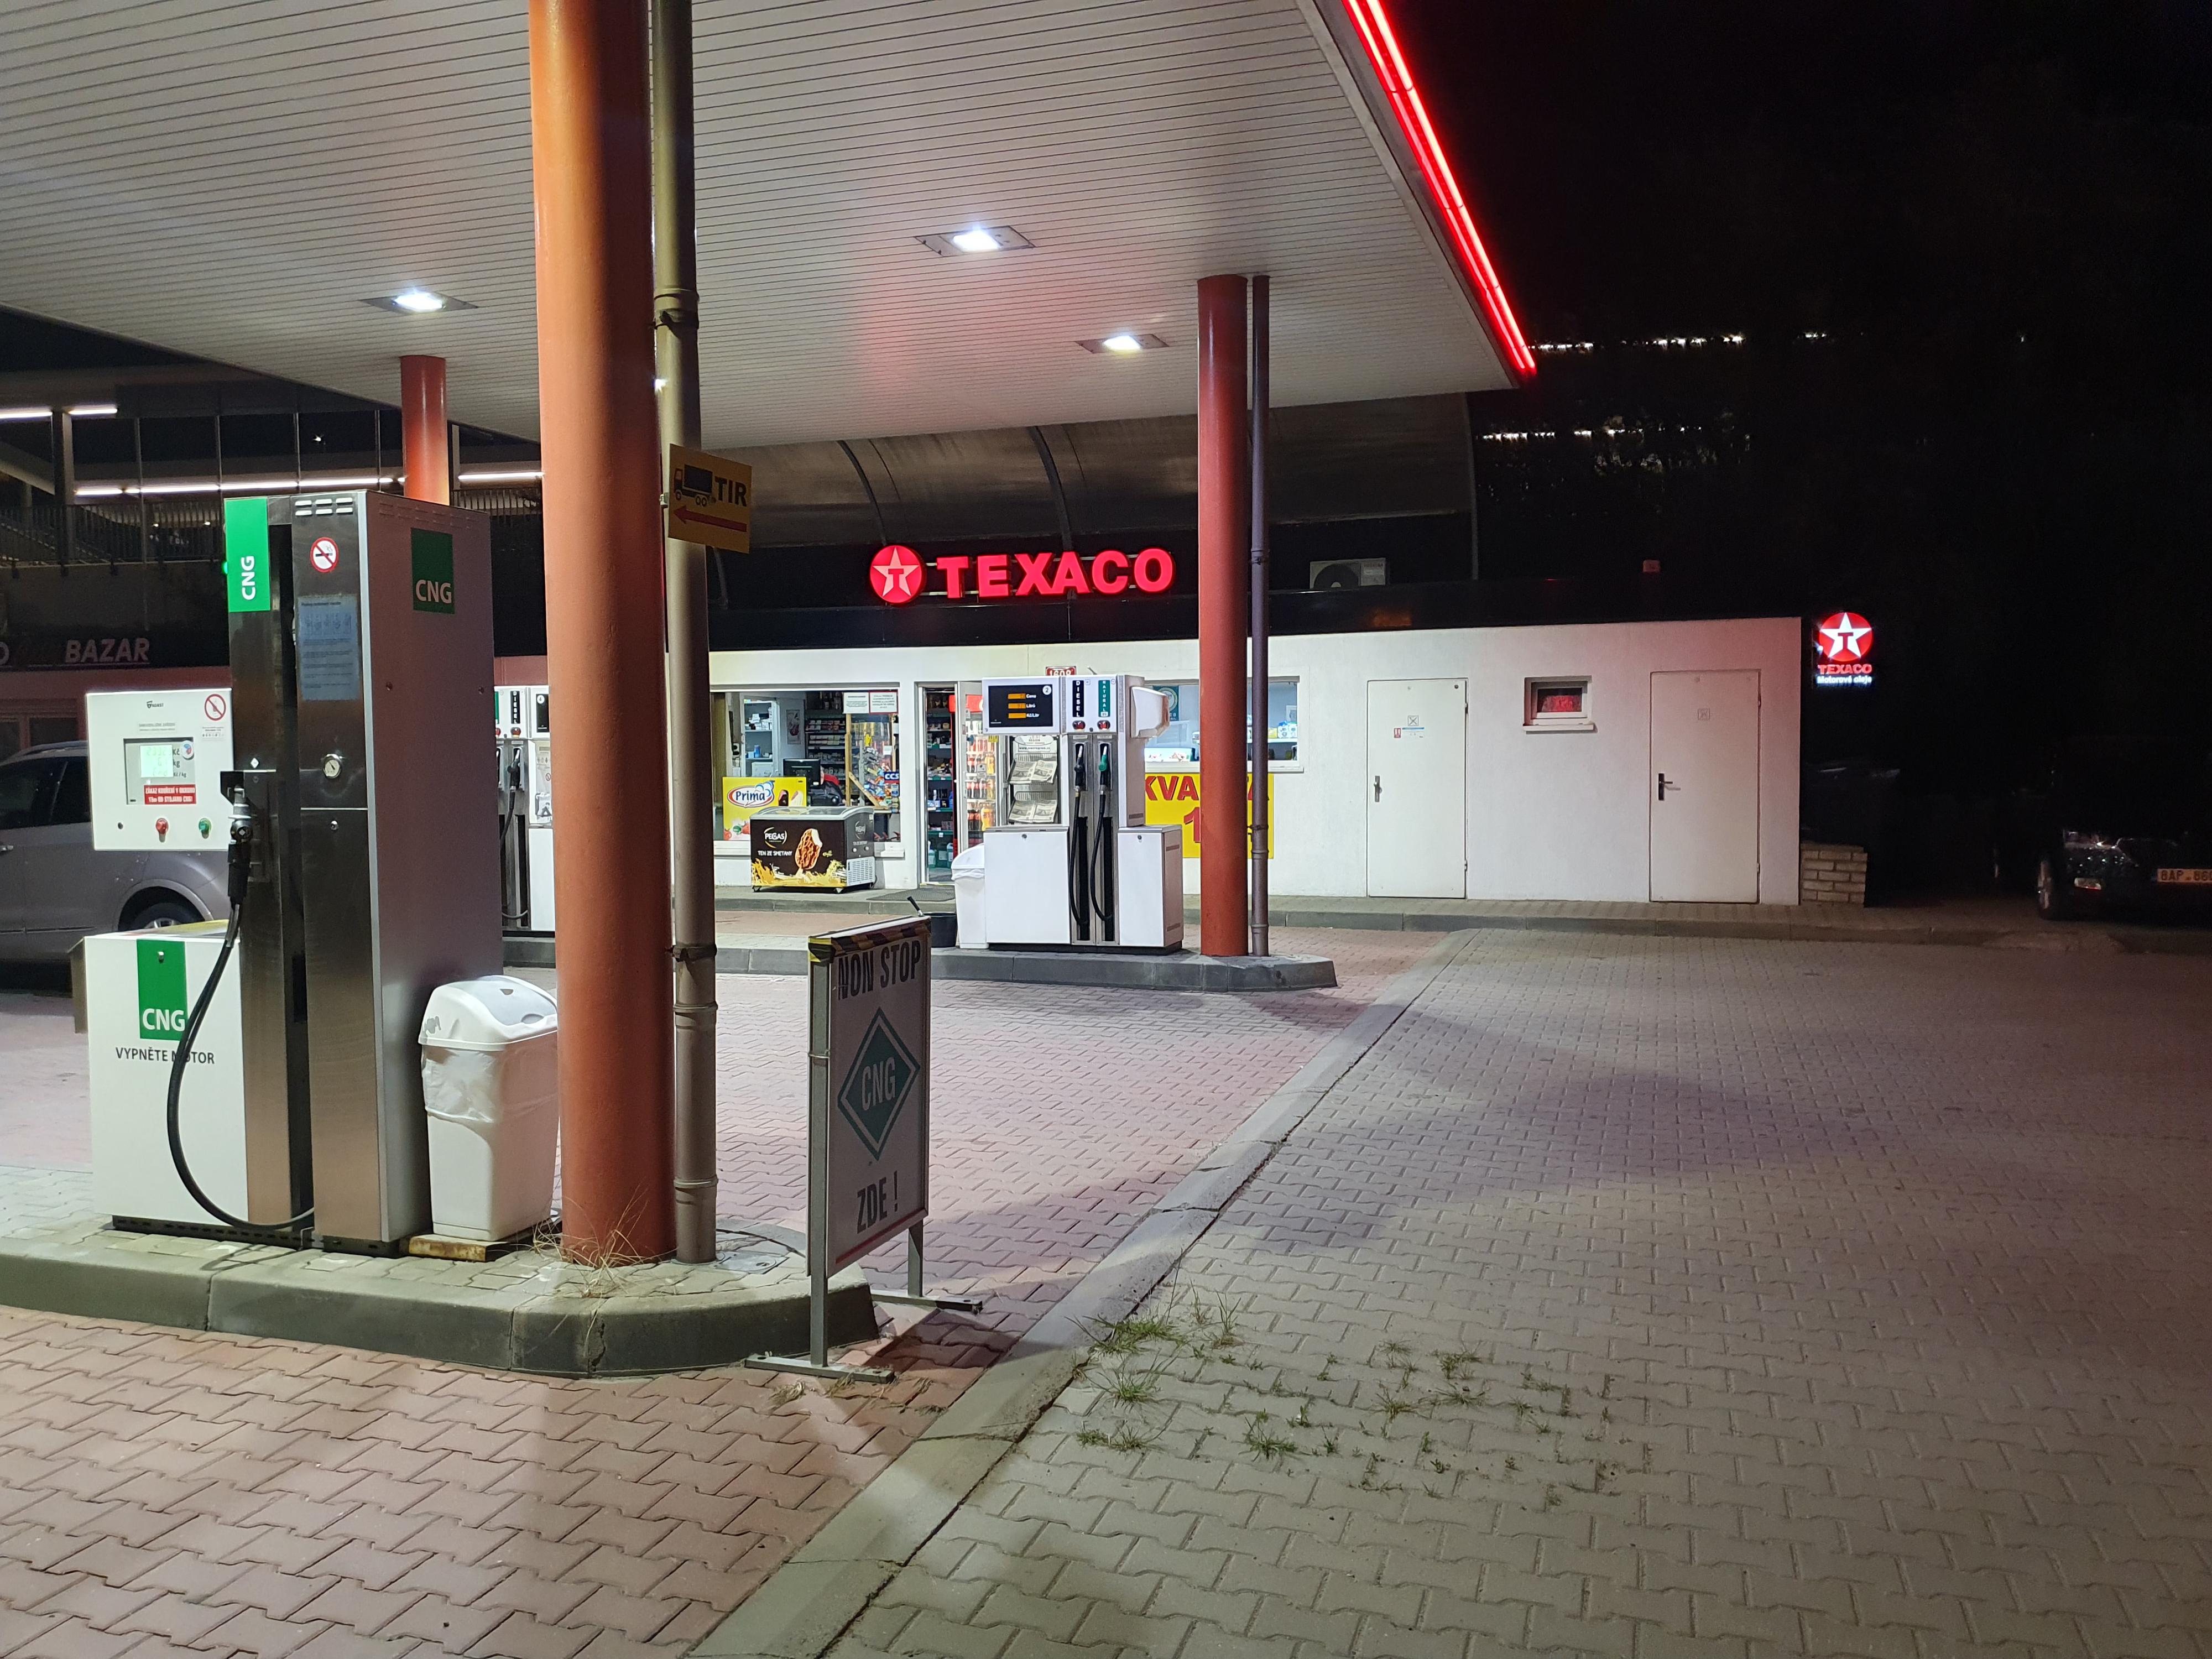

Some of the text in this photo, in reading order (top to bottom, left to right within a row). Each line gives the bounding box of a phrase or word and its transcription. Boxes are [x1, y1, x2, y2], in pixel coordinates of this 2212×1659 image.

[714, 476, 747, 507] TIR
[241, 556, 256, 601] CNG
[937, 548, 1173, 598] TEXACO
[416, 580, 452, 604] CNG
[65, 638, 150, 663] BAZAR
[1817, 664, 1872, 675] TEXACO
[1853, 675, 1872, 684] oleje
[735, 791, 765, 801] Prima
[838, 940, 921, 1000] NON STOP
[142, 1008, 186, 1032] CNG
[115, 1047, 168, 1062] VYPNĚTE
[862, 1057, 895, 1111] CNG
[857, 1176, 887, 1234] ZDE
